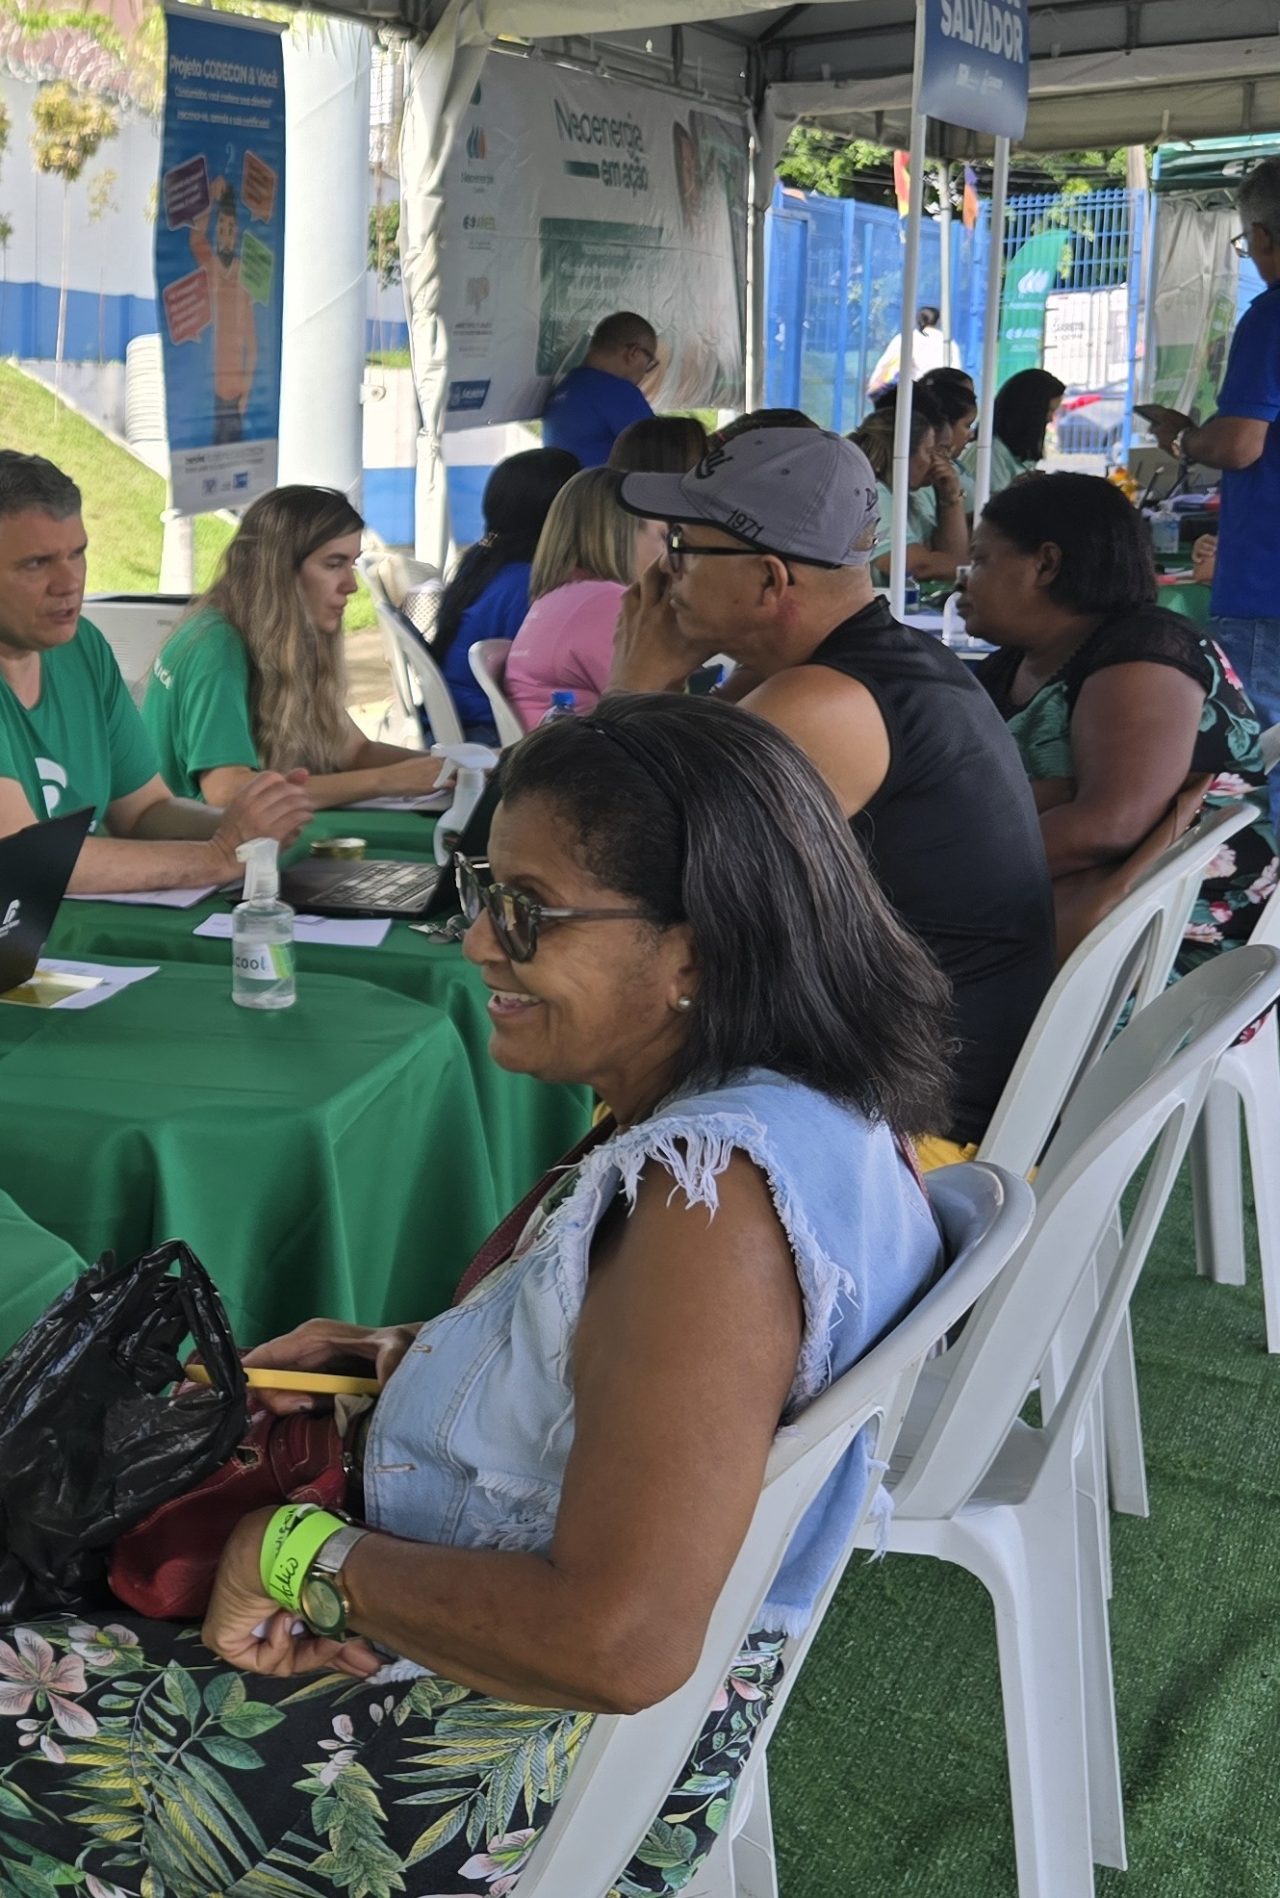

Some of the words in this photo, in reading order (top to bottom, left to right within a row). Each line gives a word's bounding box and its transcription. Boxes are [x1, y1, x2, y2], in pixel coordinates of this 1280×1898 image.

[941, 0, 1024, 64] SALVADOR
[170, 55, 202, 80] Projeto
[203, 59, 247, 84] CODECON
[554, 98, 644, 160] Neoenergia
[601, 159, 621, 187] em
[622, 157, 649, 197] ação
[726, 508, 765, 539] 1971
[235, 956, 266, 971] cool
